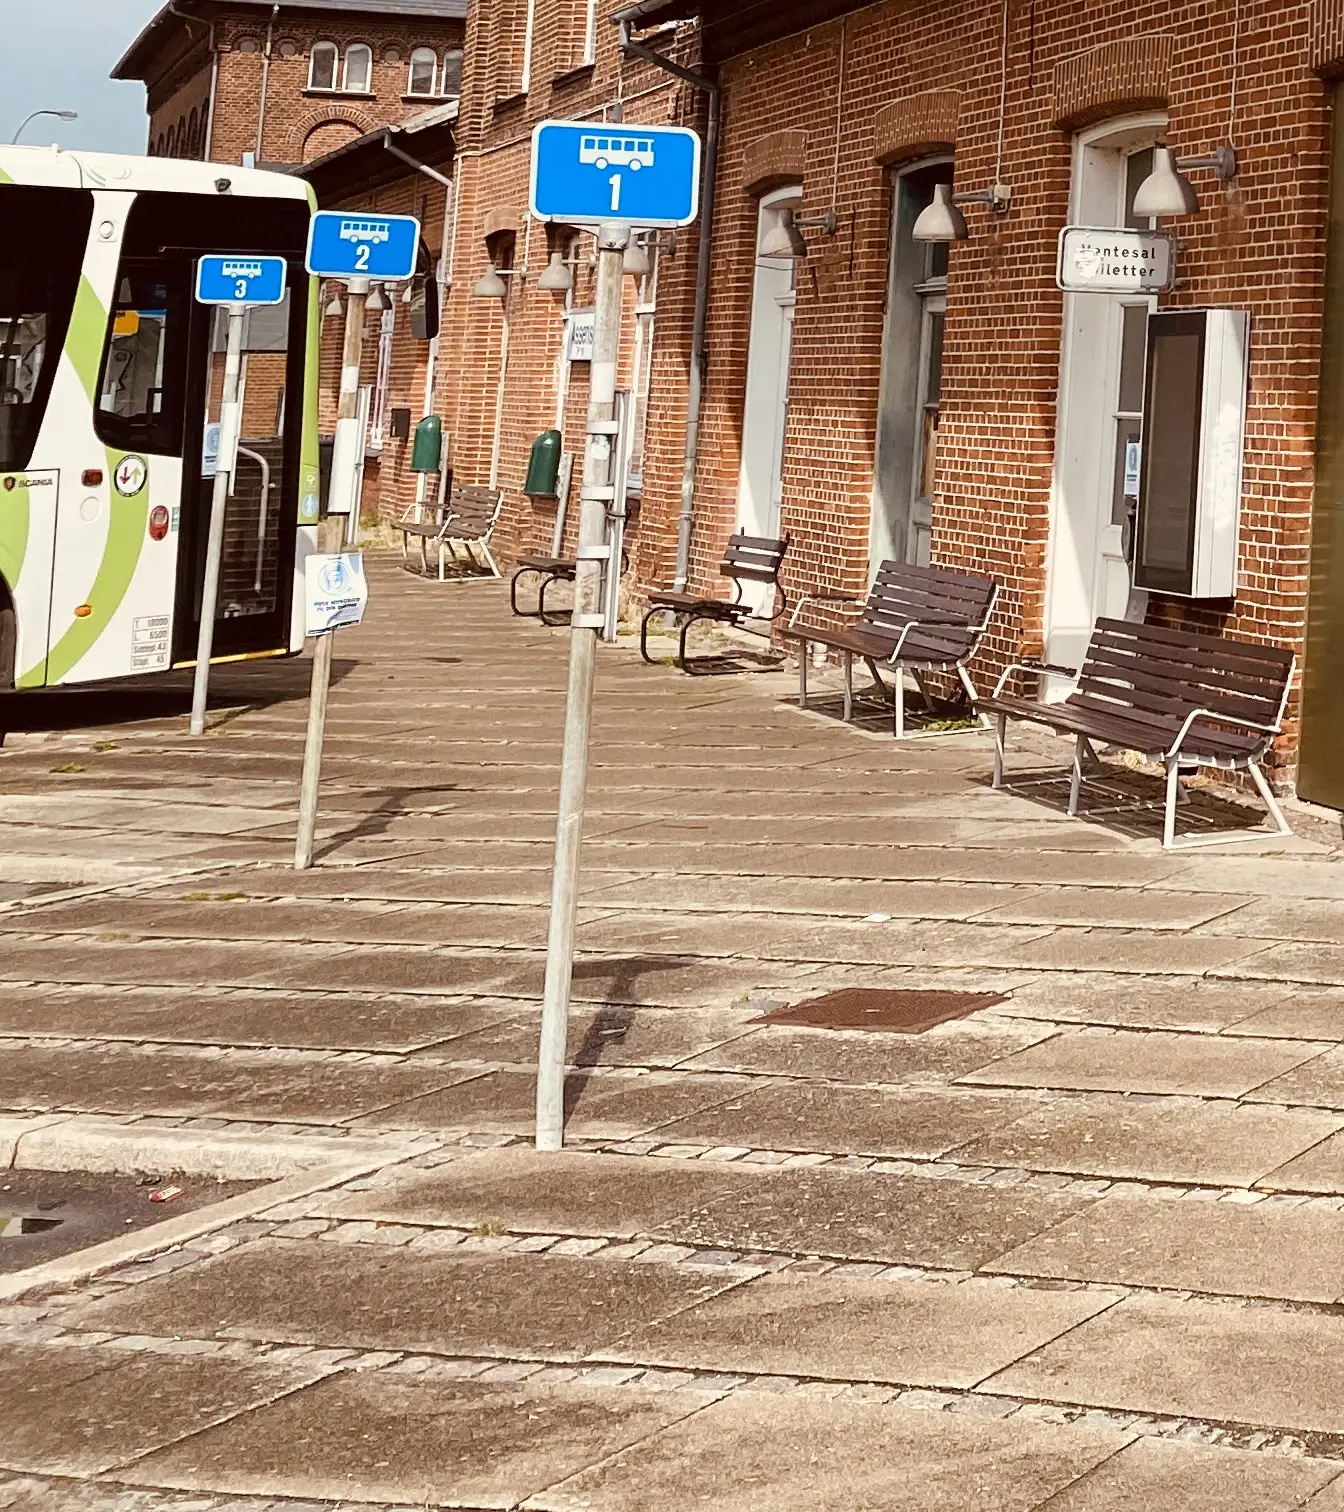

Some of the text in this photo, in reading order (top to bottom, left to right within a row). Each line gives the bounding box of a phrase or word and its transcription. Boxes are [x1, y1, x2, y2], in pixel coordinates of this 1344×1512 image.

[608, 173, 622, 211] 1
[354, 244, 371, 271] 2
[234, 279, 247, 299] 3
